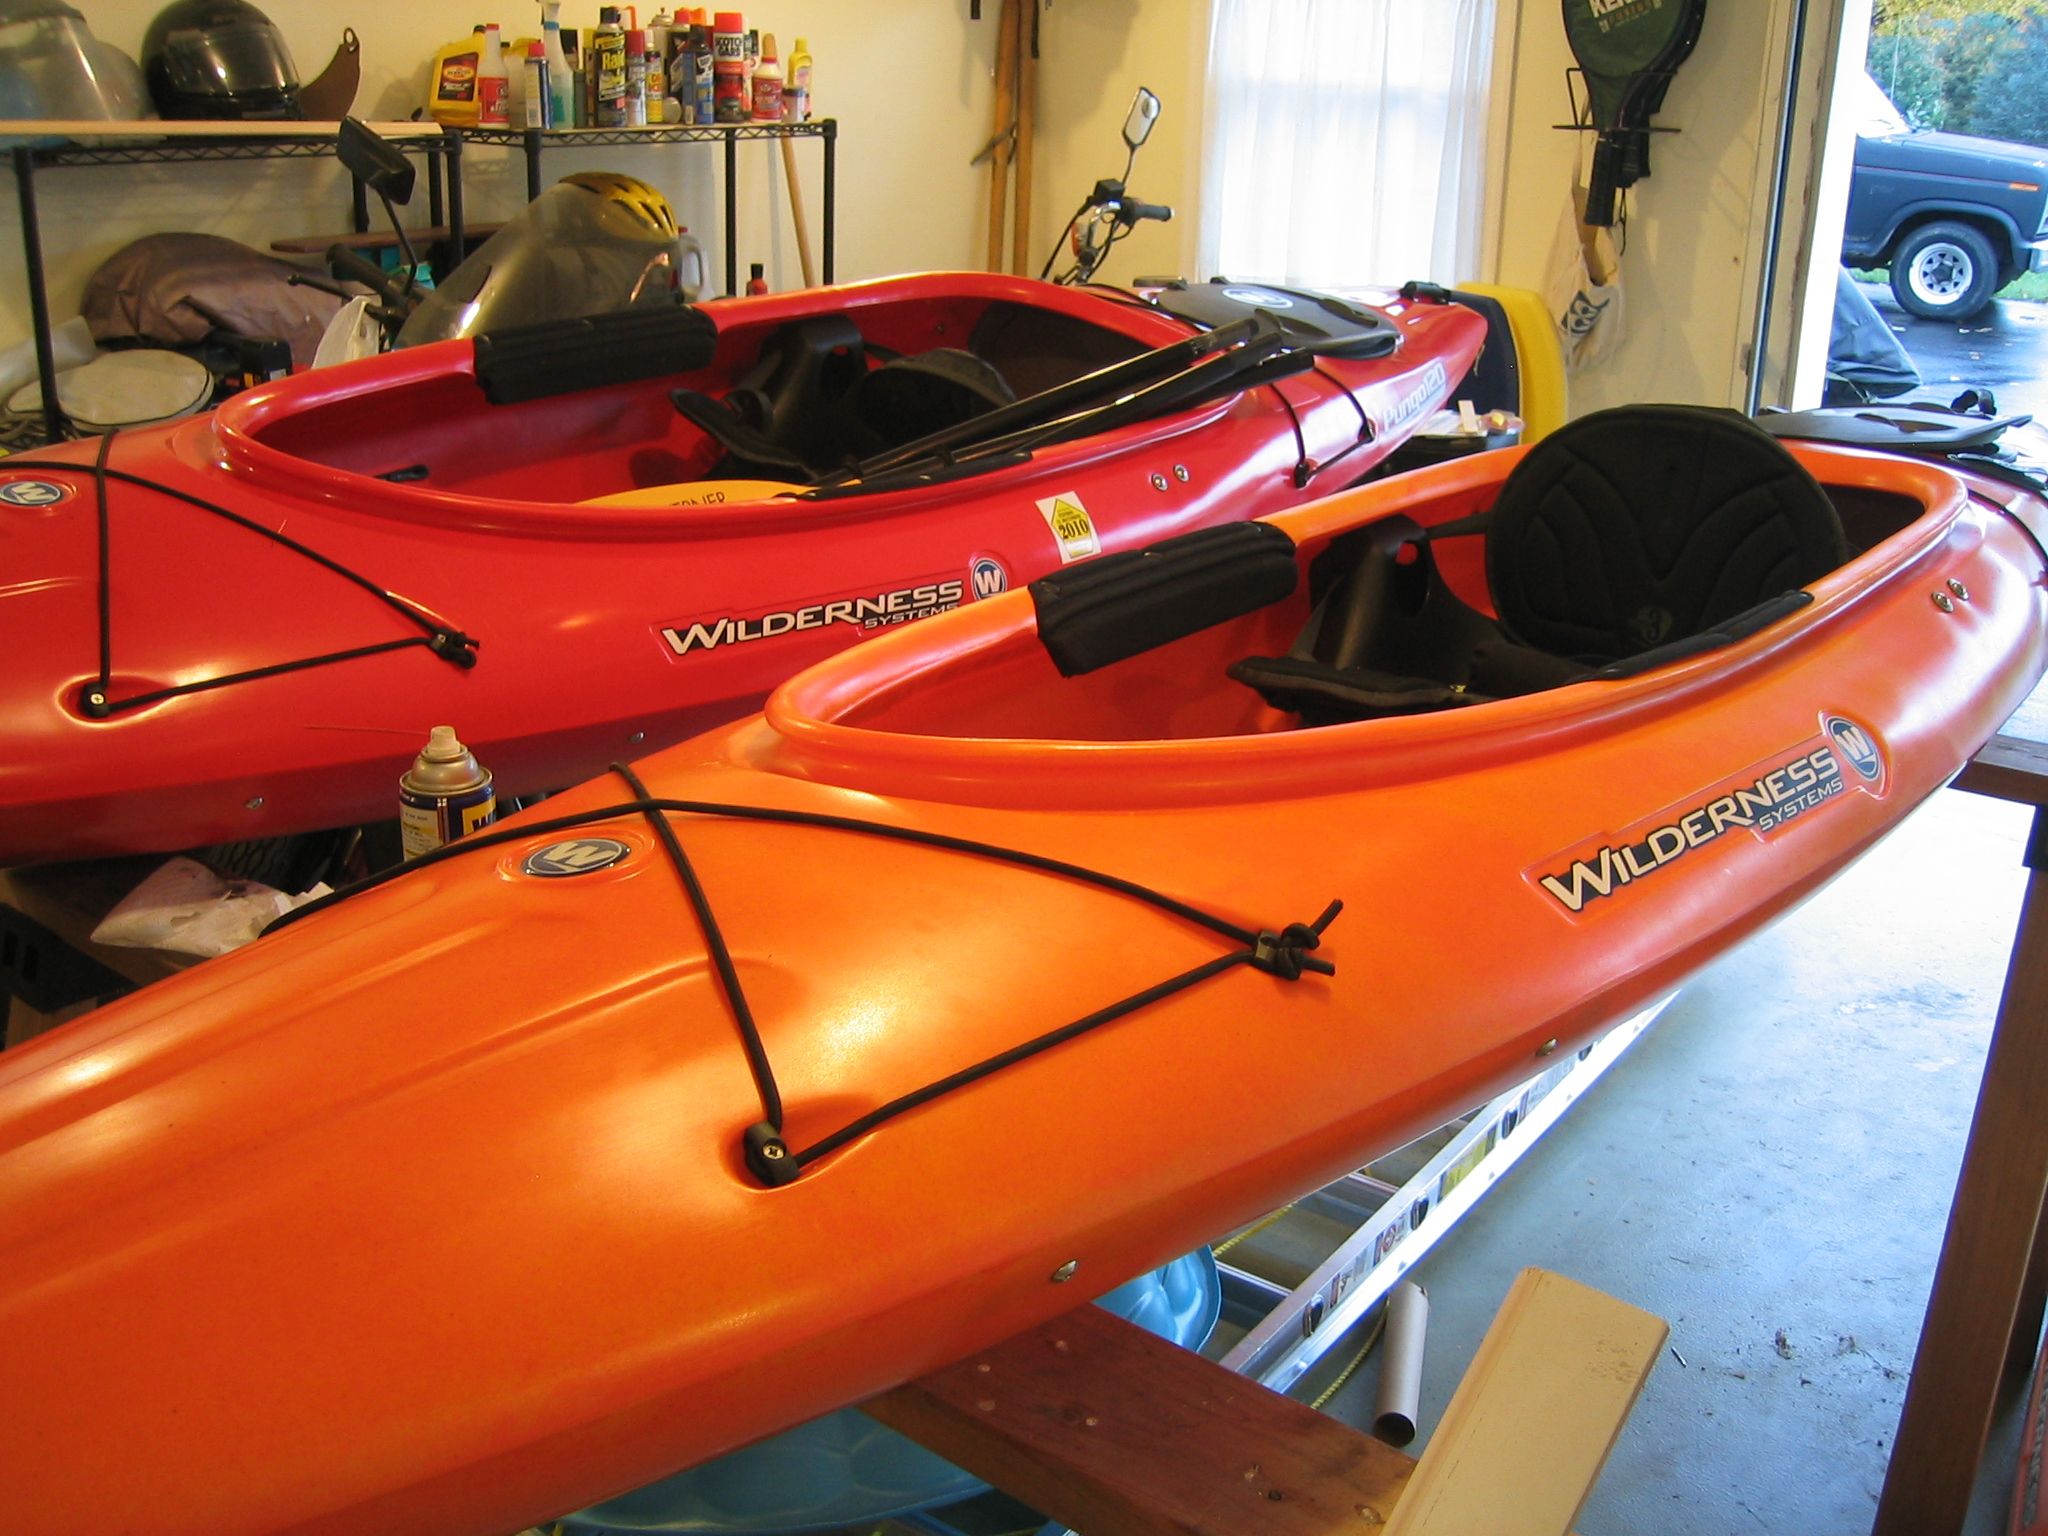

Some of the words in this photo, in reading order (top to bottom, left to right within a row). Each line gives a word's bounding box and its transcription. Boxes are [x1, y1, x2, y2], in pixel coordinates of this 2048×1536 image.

[1058, 518, 1089, 540] 2010
[975, 570, 1002, 595] W
[661, 580, 963, 655] WILDERNESS
[1834, 725, 1870, 763] W
[1758, 776, 1844, 832] SYSTEMS
[1541, 747, 1841, 911] WILDERNESS
